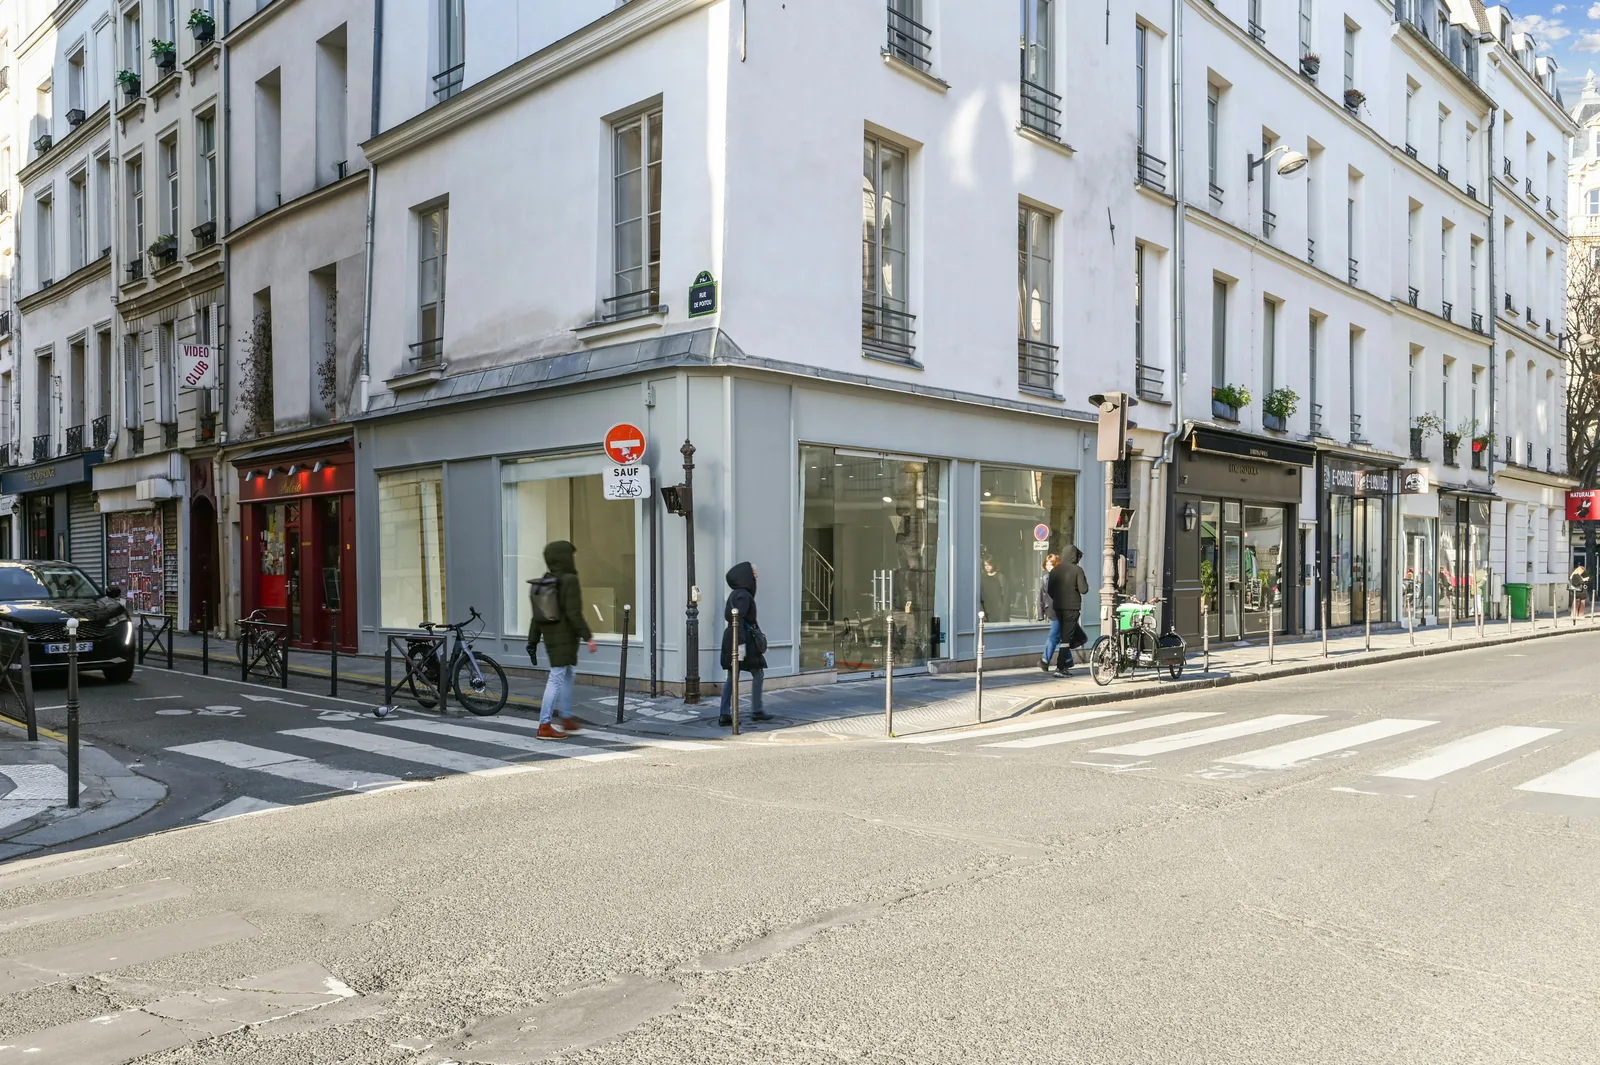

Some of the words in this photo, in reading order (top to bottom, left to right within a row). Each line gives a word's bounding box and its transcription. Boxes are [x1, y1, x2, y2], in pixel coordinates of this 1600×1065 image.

[699, 299, 713, 307] POITOU
[184, 345, 209, 358] VIDEO
[185, 360, 209, 386] CLUB
[613, 467, 639, 477] SAUF
